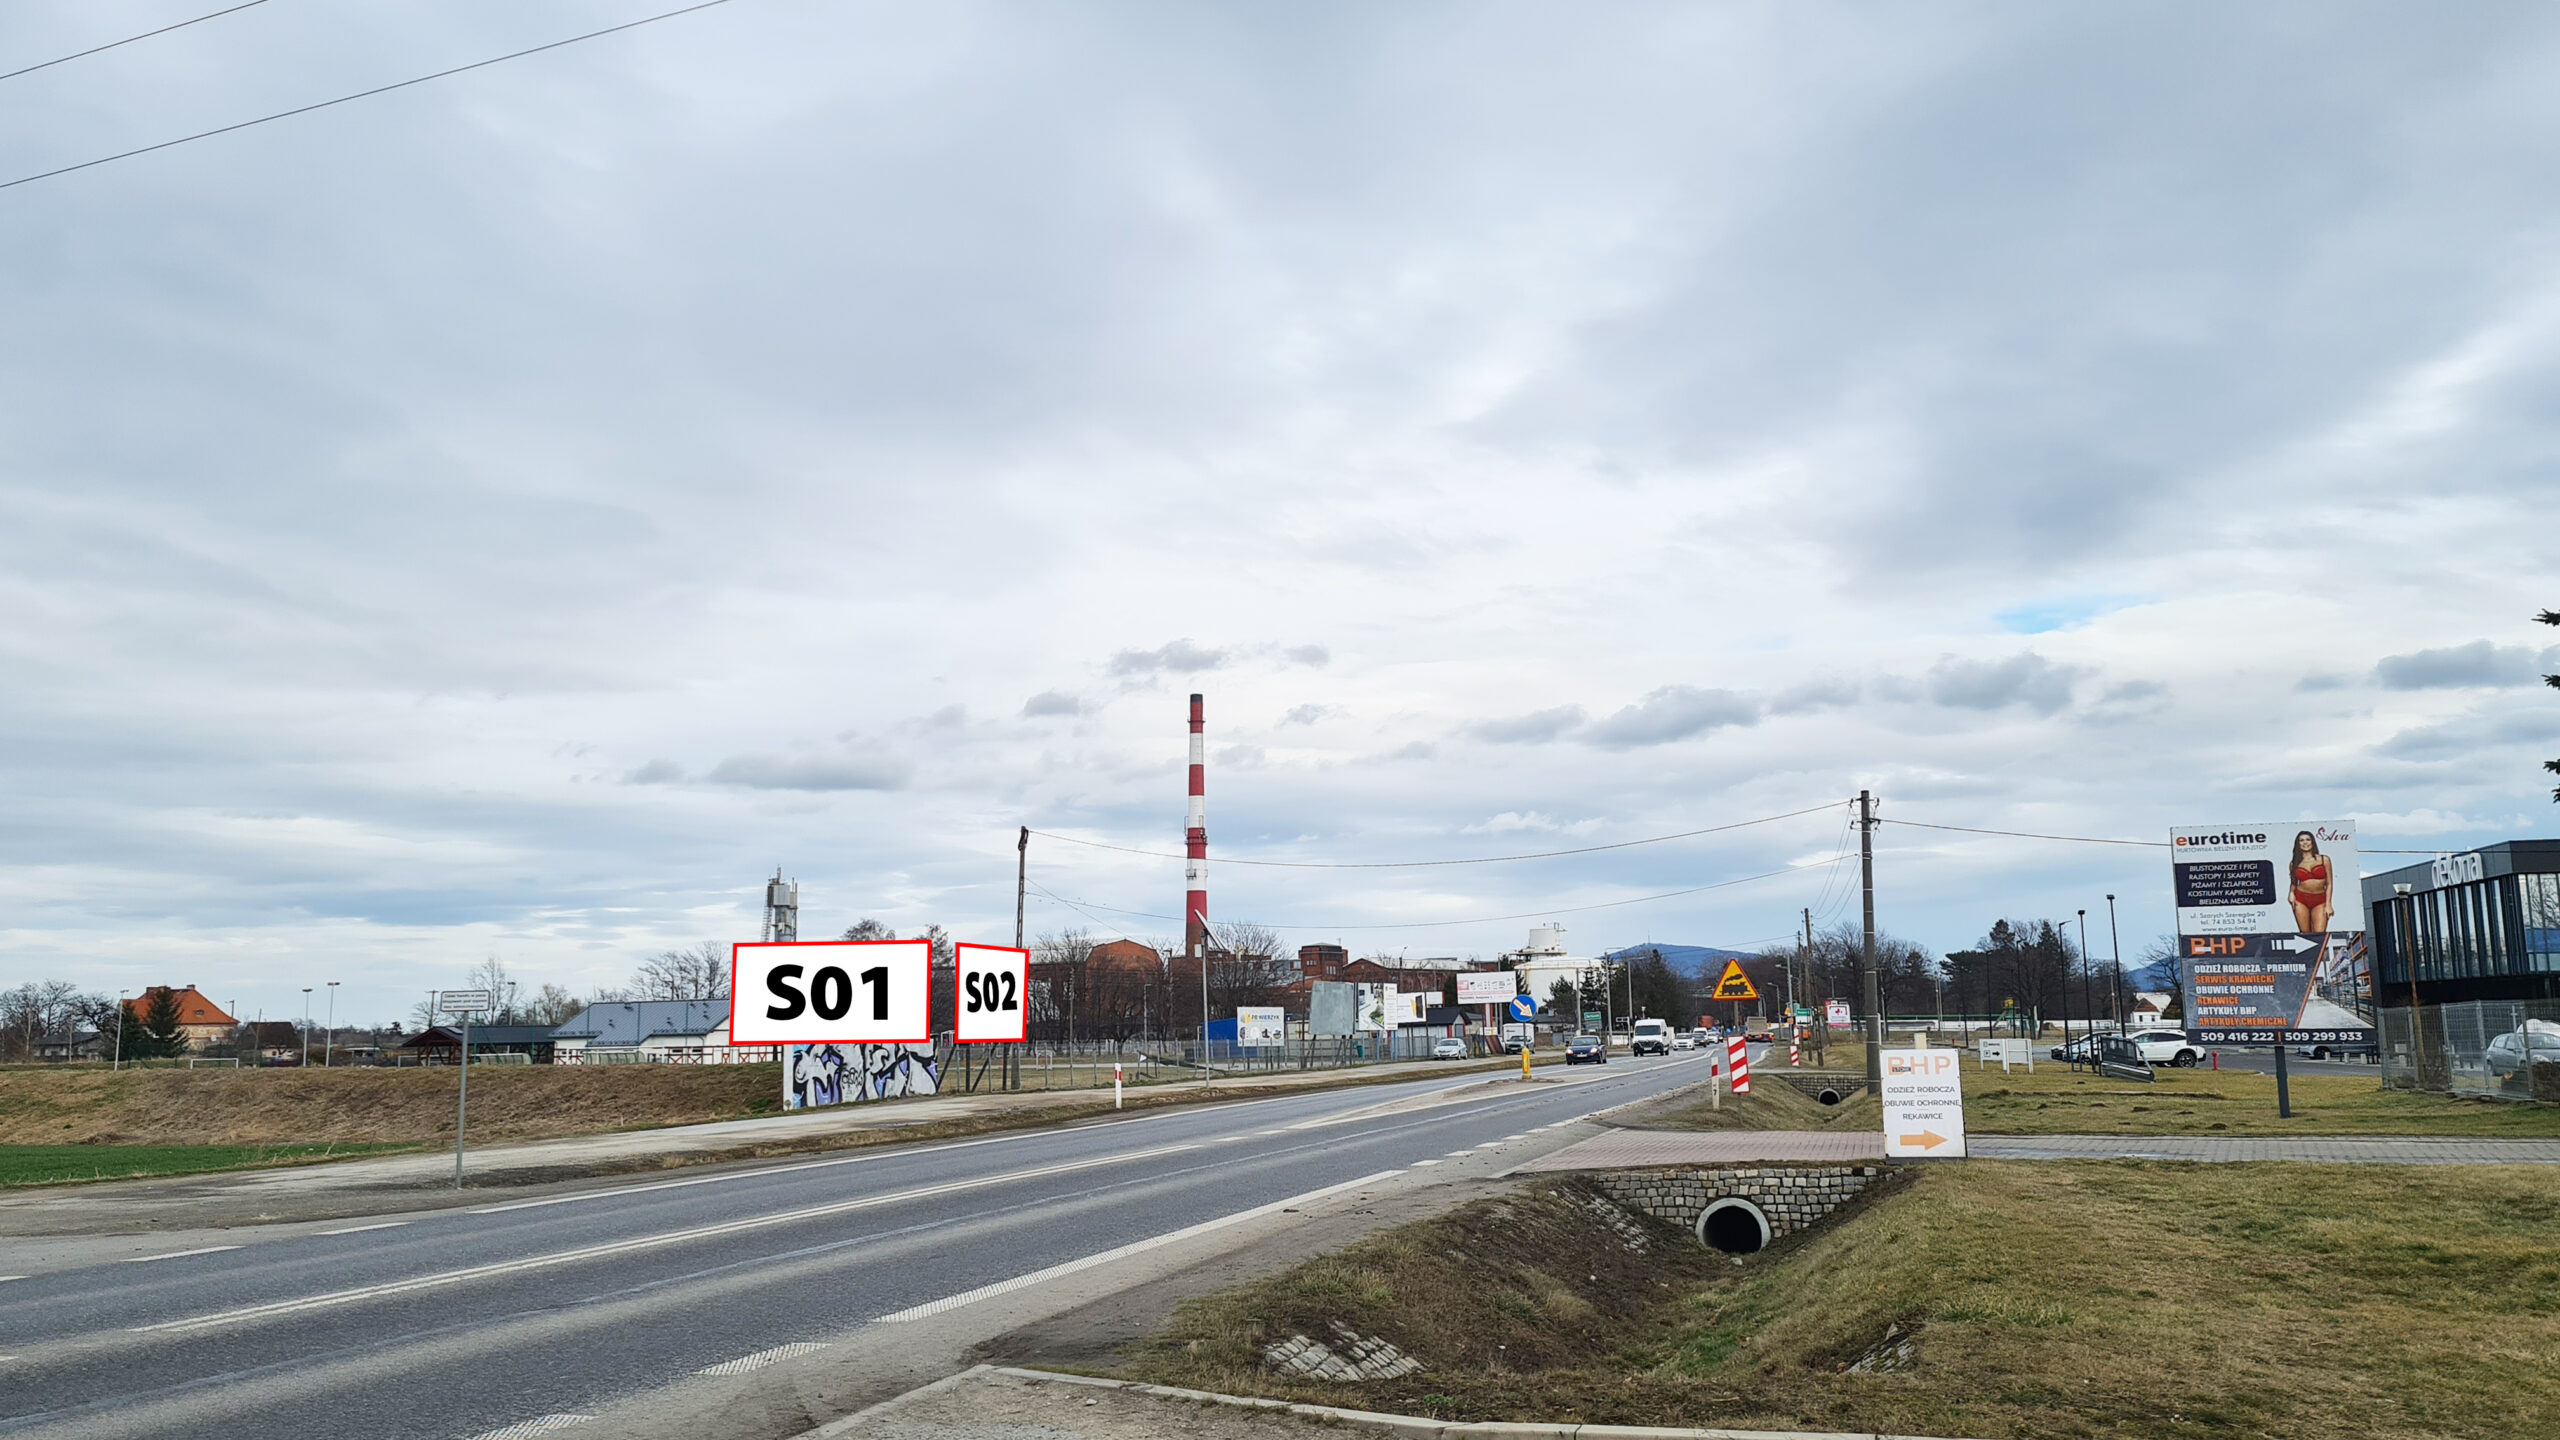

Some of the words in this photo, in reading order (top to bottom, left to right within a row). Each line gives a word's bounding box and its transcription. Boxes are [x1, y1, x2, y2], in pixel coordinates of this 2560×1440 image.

[2176, 831, 2266, 846] eurotime
[2189, 864, 2238, 872] BIUSTONOSZE
[2432, 852, 2483, 889] dekona
[2224, 888, 2264, 896] KĄPIELOWE
[2190, 937, 2246, 955] BHP
[2194, 964, 2222, 973] ODZIEŻ
[2222, 964, 2261, 973] ROBOCZA
[2266, 963, 2306, 972] PREMIUM
[2194, 975, 2228, 984] SERWIS
[2228, 974, 2275, 984] KRAWIECKI
[2195, 985, 2229, 994] OBUWIE
[2230, 985, 2275, 994] OCHRONNE
[2240, 1006, 2257, 1015] BHP
[2241, 1017, 2288, 1026] CHEMICZNE
[2201, 1032, 2225, 1040] 509
[2228, 1032, 2248, 1040] 416
[2252, 1032, 2274, 1040] 222
[2285, 1032, 2309, 1040] 509
[2312, 1032, 2336, 1040] 299
[2339, 1031, 2363, 1040] 933
[1887, 1056, 1951, 1075] BHP
